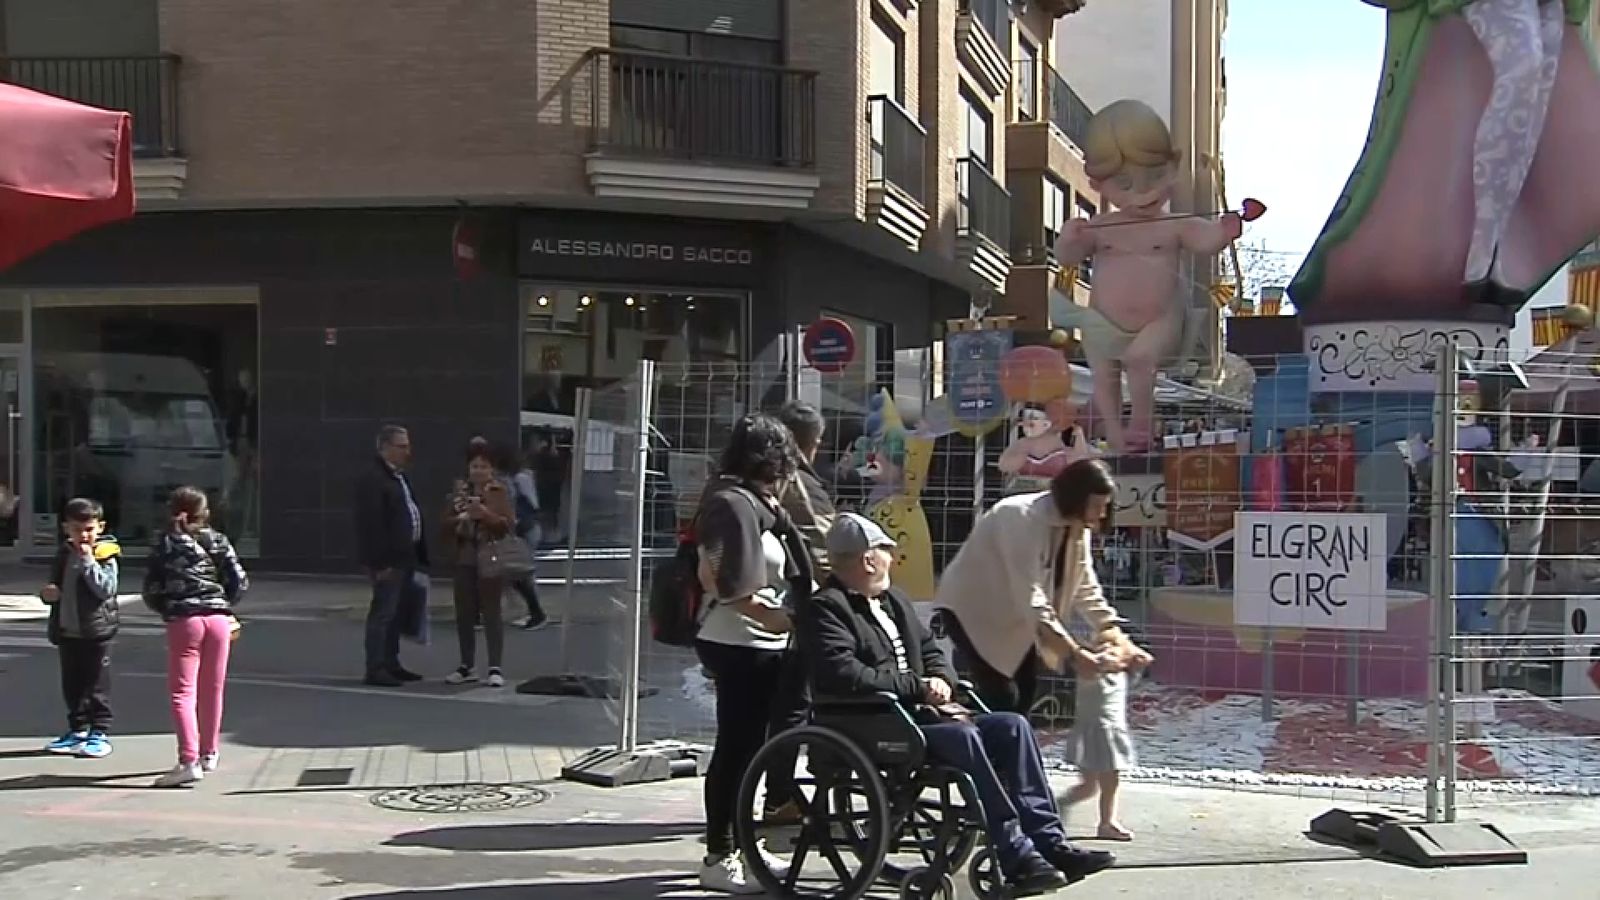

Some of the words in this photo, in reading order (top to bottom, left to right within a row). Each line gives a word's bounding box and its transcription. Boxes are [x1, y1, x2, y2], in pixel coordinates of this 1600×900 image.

[531, 239, 674, 261] ALESSANDRO
[683, 246, 751, 264] SACCO
[1270, 572, 1347, 616] CIRC
